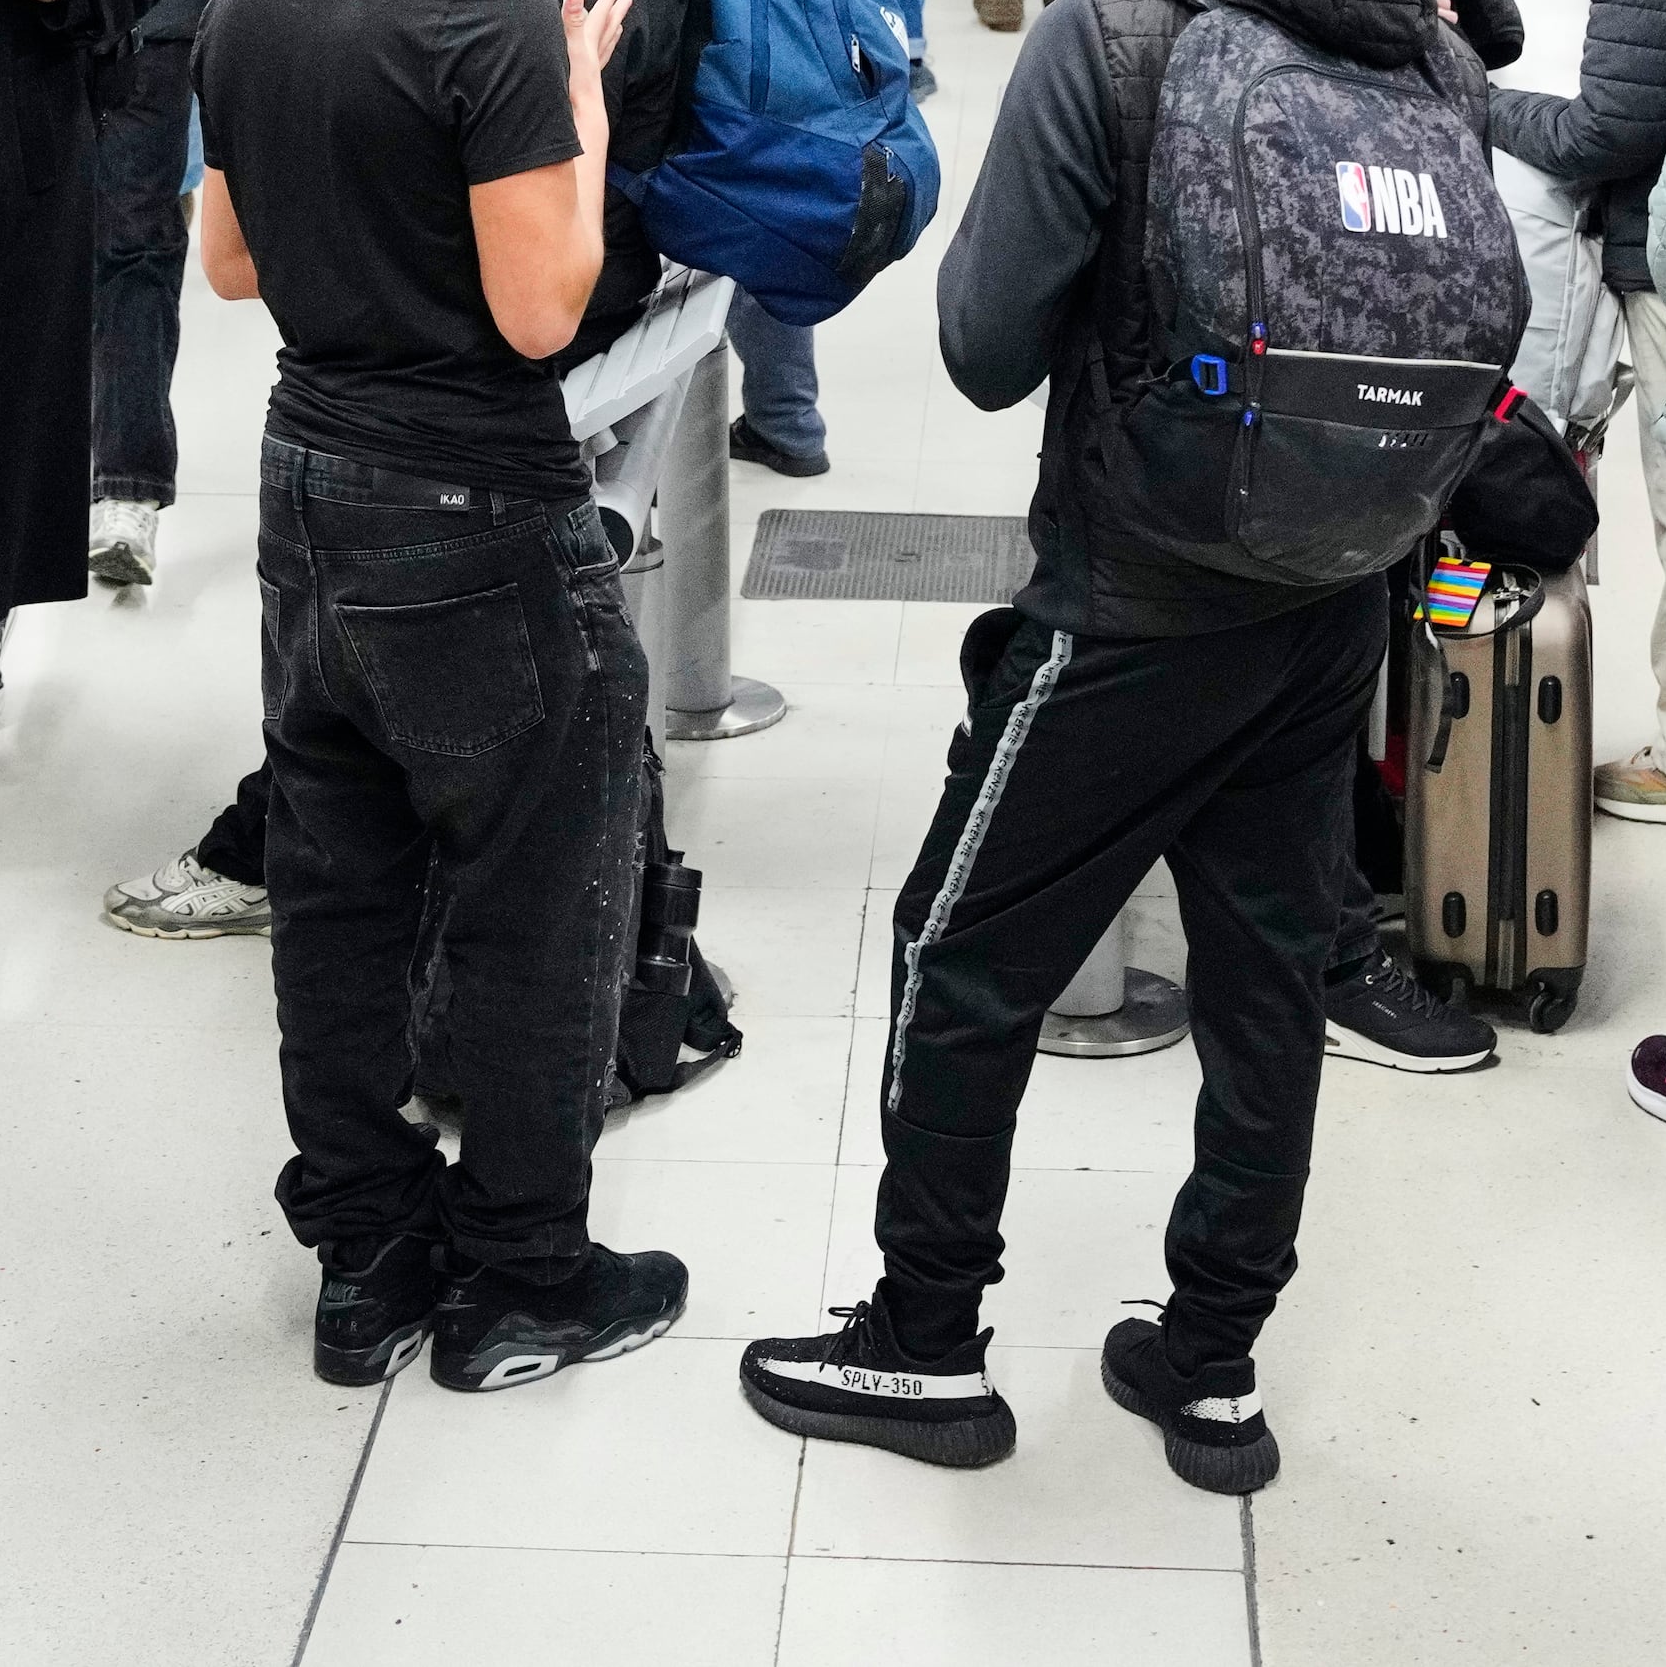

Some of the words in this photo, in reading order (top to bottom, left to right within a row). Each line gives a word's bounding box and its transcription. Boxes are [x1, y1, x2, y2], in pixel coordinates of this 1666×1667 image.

[1368, 165, 1448, 239] NBA
[1357, 383, 1424, 407] TARMAK
[841, 1369, 923, 1397] SPLY-350
